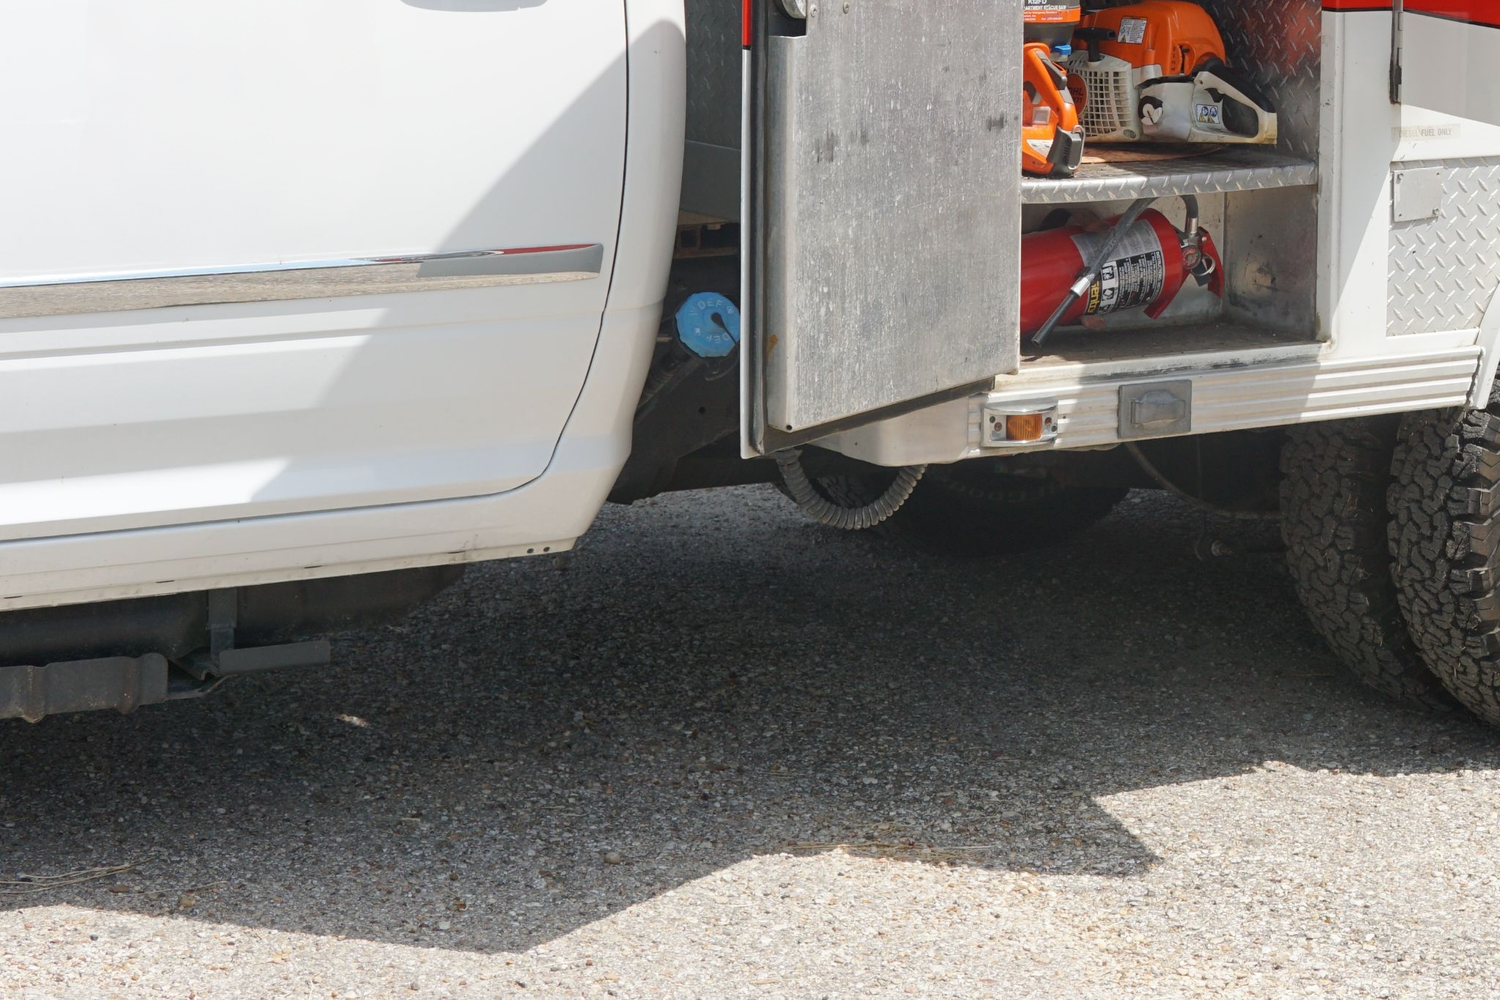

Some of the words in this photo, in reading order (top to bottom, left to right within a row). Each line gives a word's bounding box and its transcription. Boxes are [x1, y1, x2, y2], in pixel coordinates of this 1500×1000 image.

[1420, 128, 1435, 137] FUEL
[1437, 127, 1453, 137] ONLY
[697, 298, 723, 310] DEF
